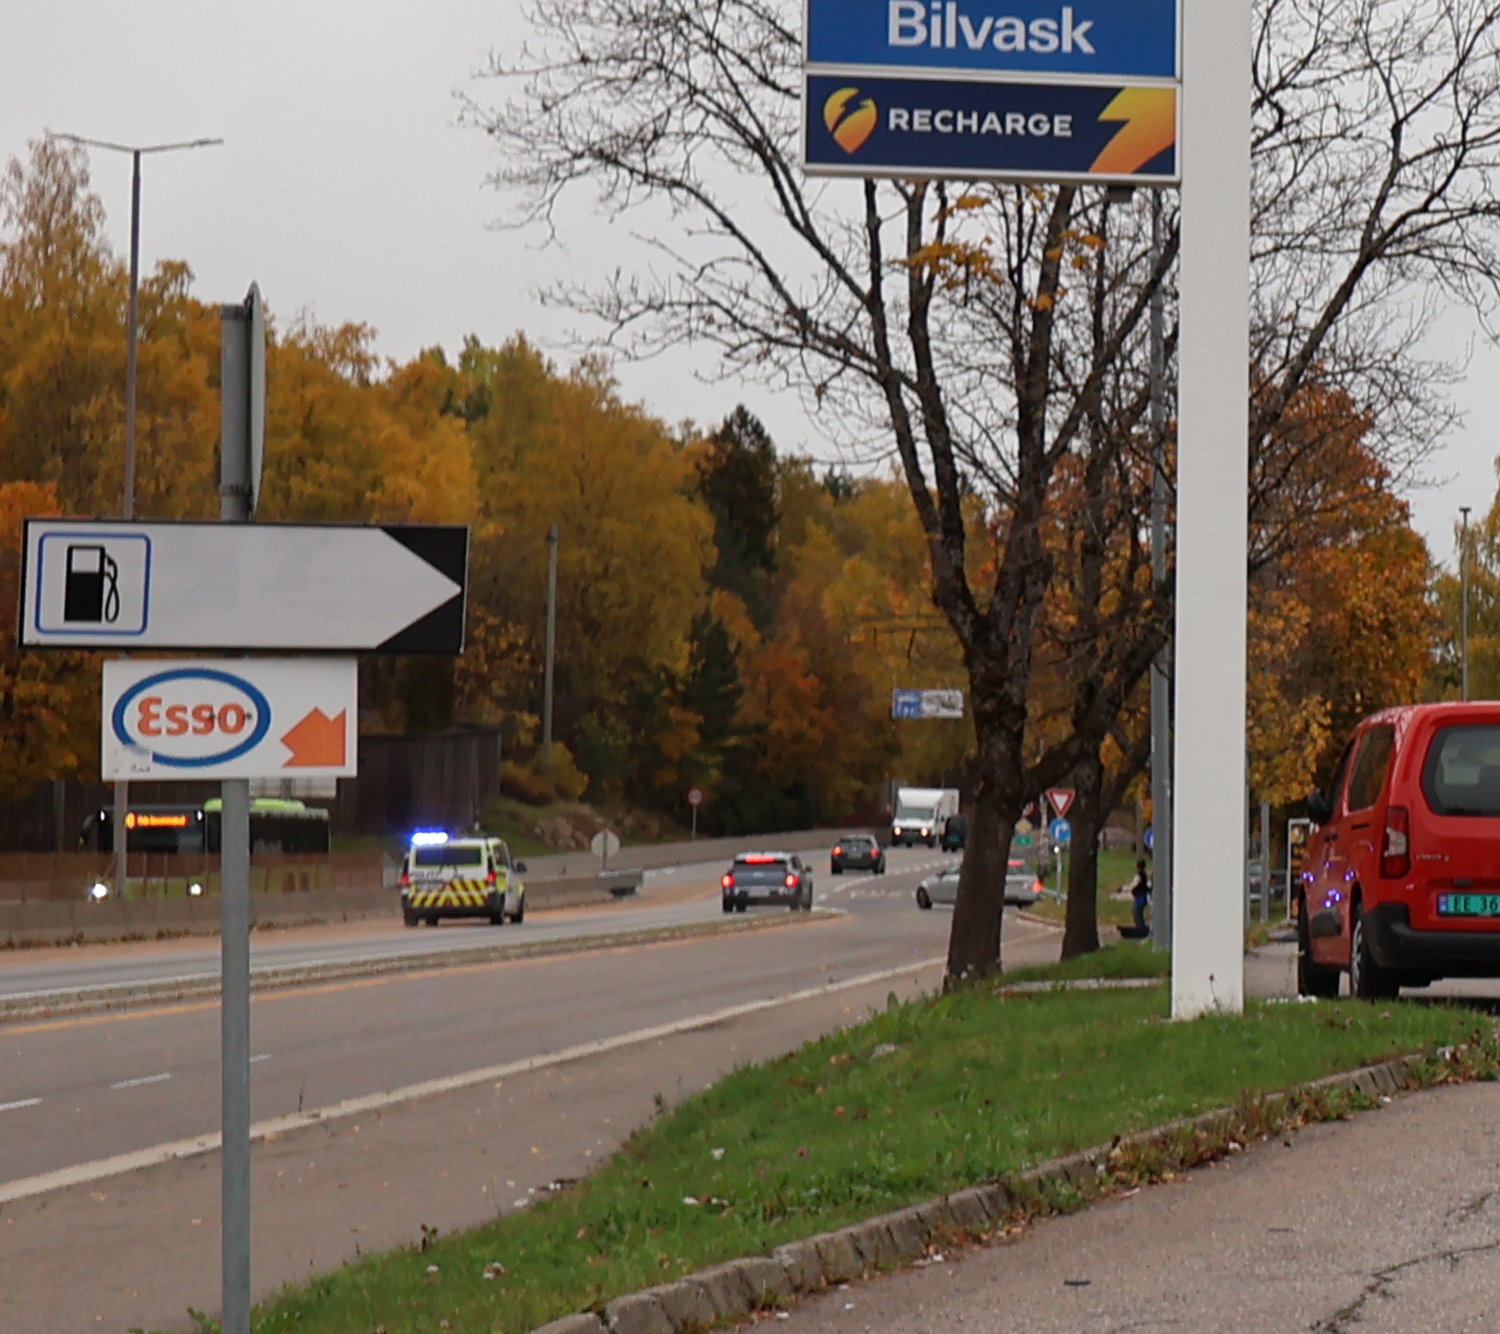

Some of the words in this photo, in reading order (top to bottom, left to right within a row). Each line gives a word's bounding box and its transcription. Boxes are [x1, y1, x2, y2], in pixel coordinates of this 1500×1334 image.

[887, 0, 1096, 54] Bilvask
[888, 107, 1073, 138] RECHARGE
[1453, 896, 1471, 912] EE
